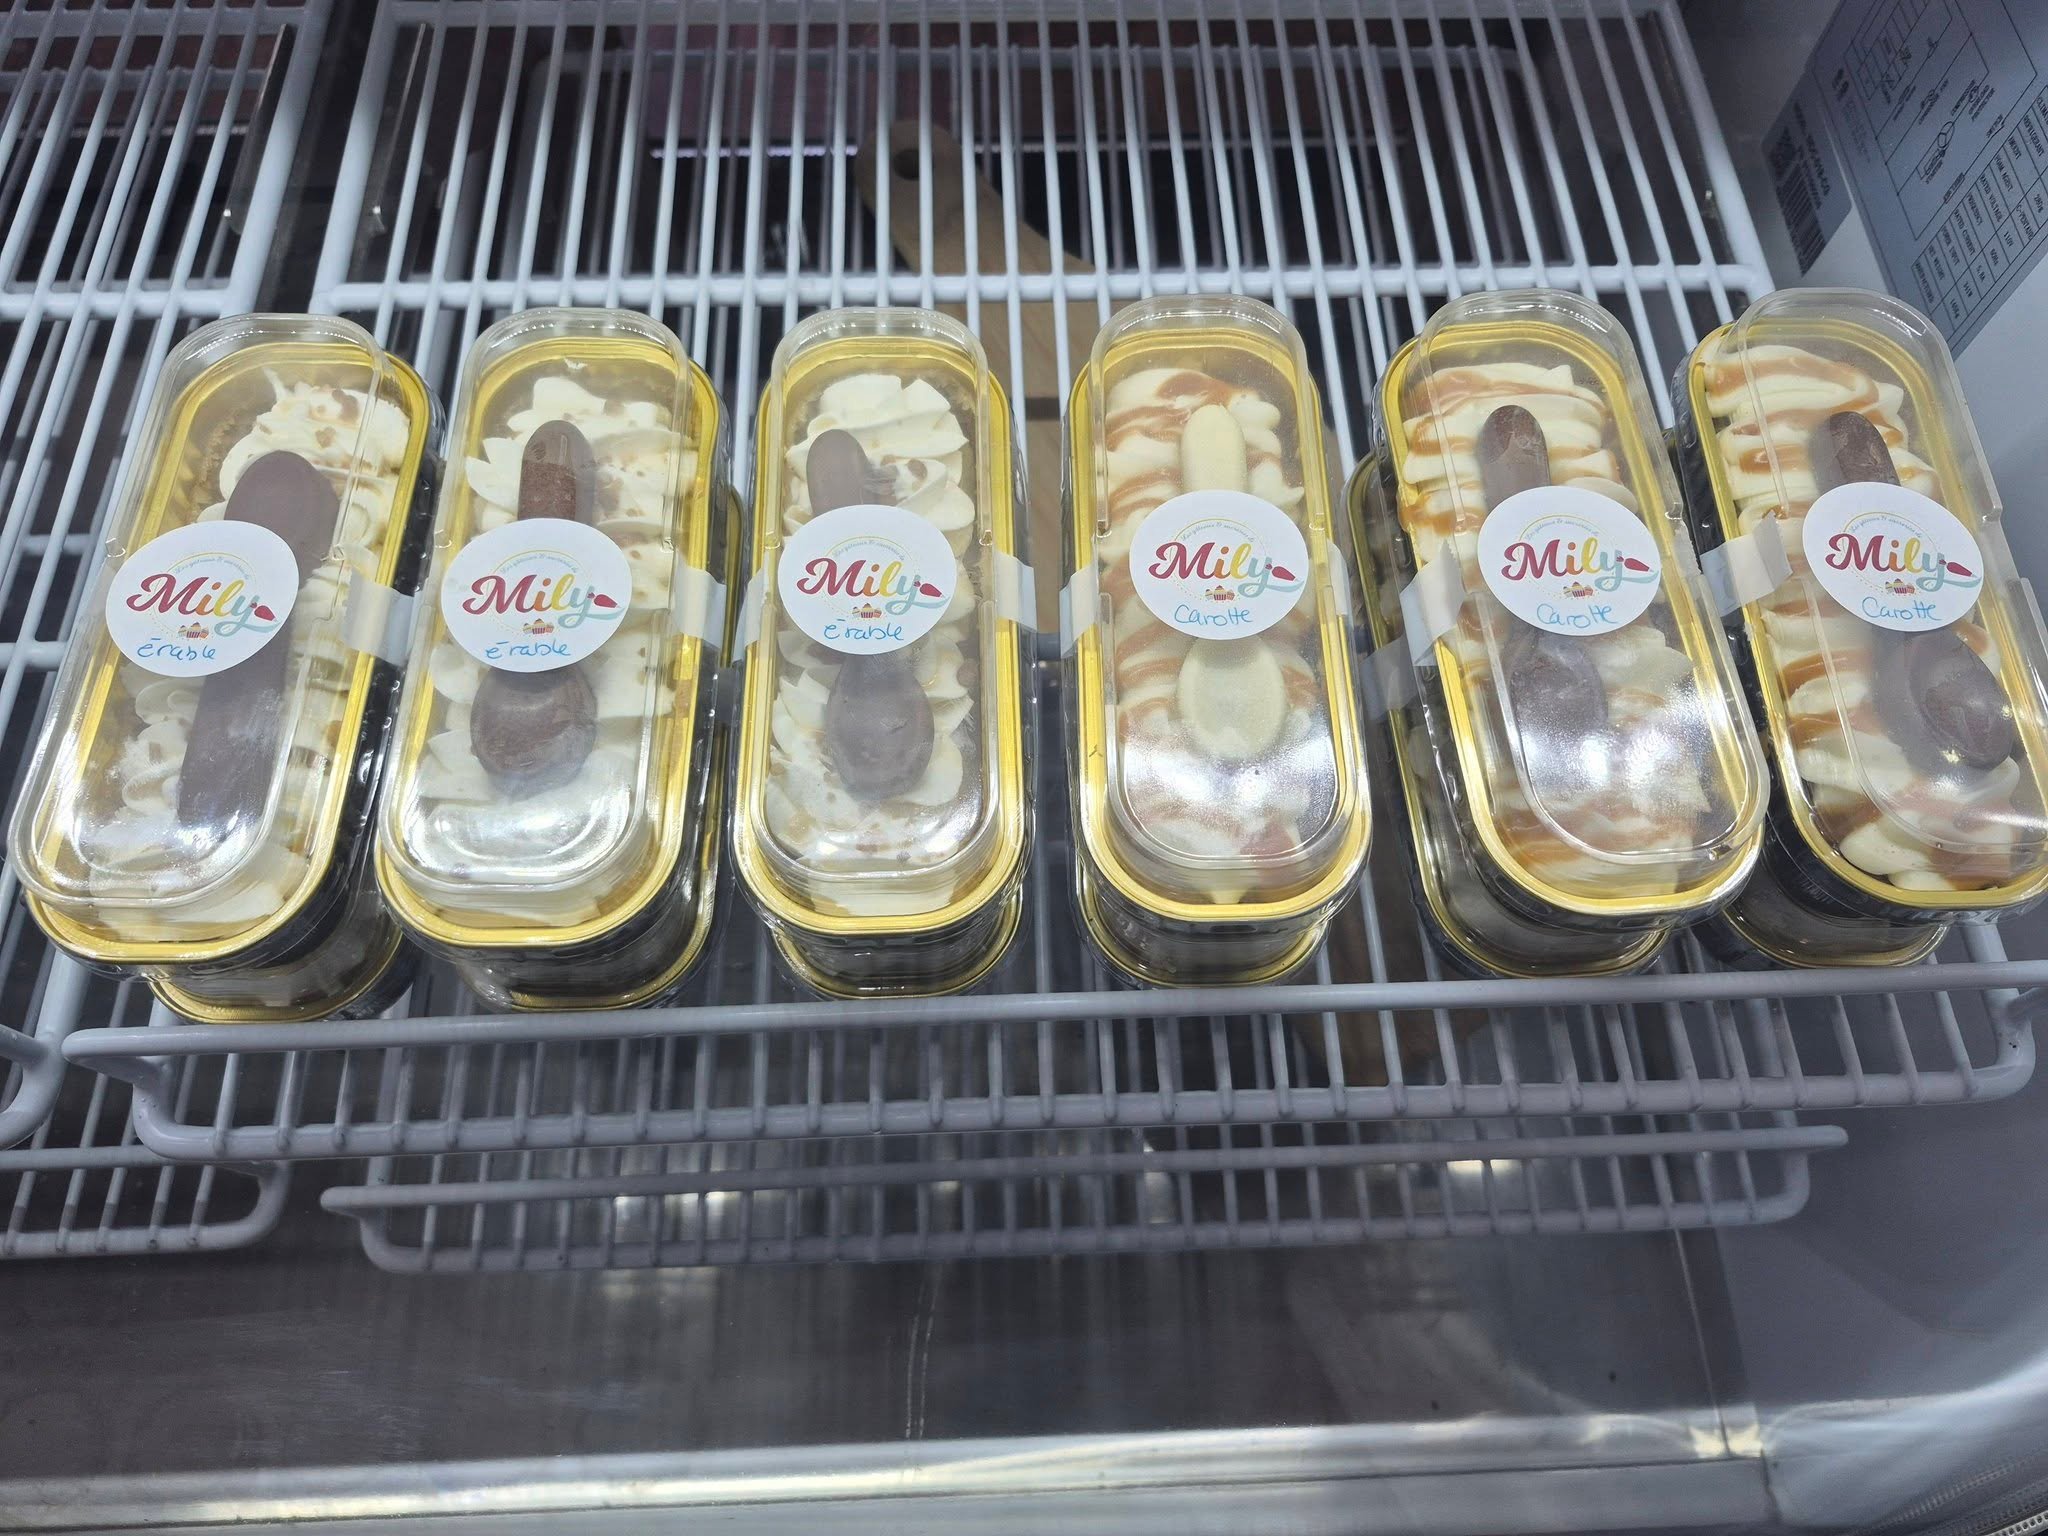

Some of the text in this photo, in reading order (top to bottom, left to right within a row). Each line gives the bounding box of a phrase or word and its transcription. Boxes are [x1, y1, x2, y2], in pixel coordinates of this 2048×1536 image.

[796, 557, 951, 615] Mily
[1148, 541, 1304, 598] Mily
[1501, 536, 1659, 592] Mily
[1825, 533, 1982, 593] Mily
[126, 573, 282, 637] Mily
[462, 573, 625, 628] Mily
[1173, 604, 1254, 627] Carotte
[1536, 603, 1620, 629] Carotte
[1861, 596, 1944, 620] Carotte
